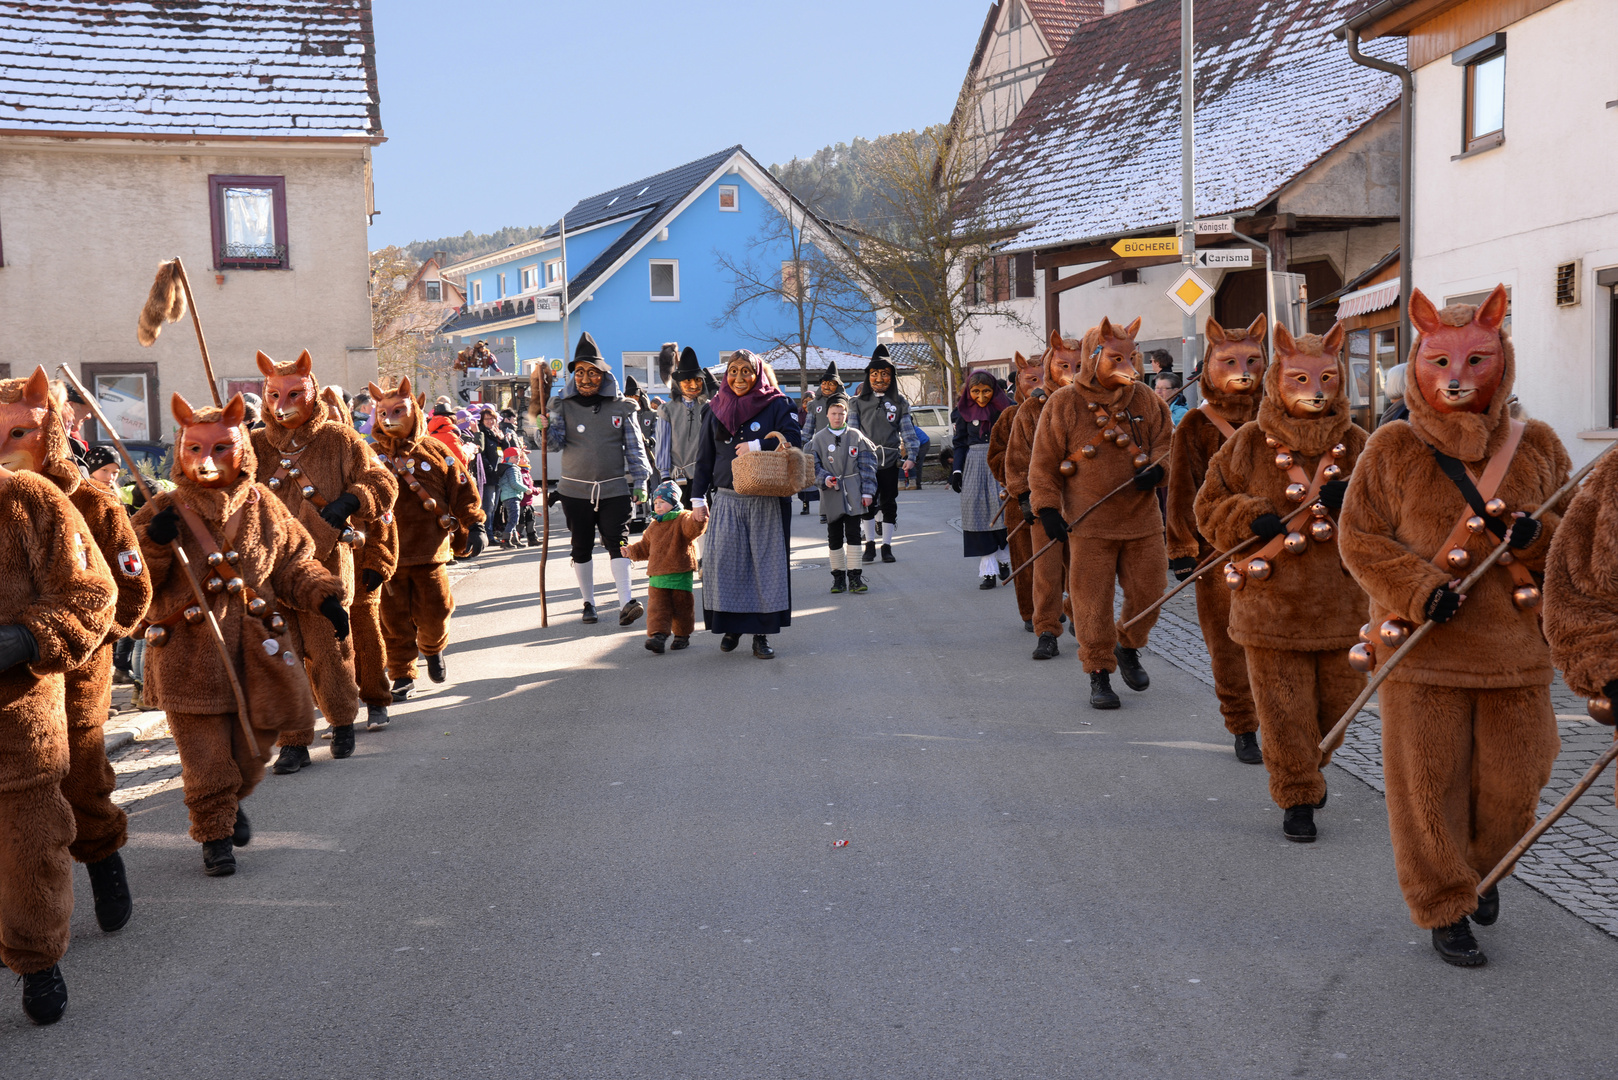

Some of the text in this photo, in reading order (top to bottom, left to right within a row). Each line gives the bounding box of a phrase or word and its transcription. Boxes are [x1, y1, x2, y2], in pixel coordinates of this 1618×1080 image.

[1199, 223, 1229, 232] Königstr.
[1125, 242, 1174, 252] BÜCHEREI
[1208, 254, 1249, 262] Carisma
